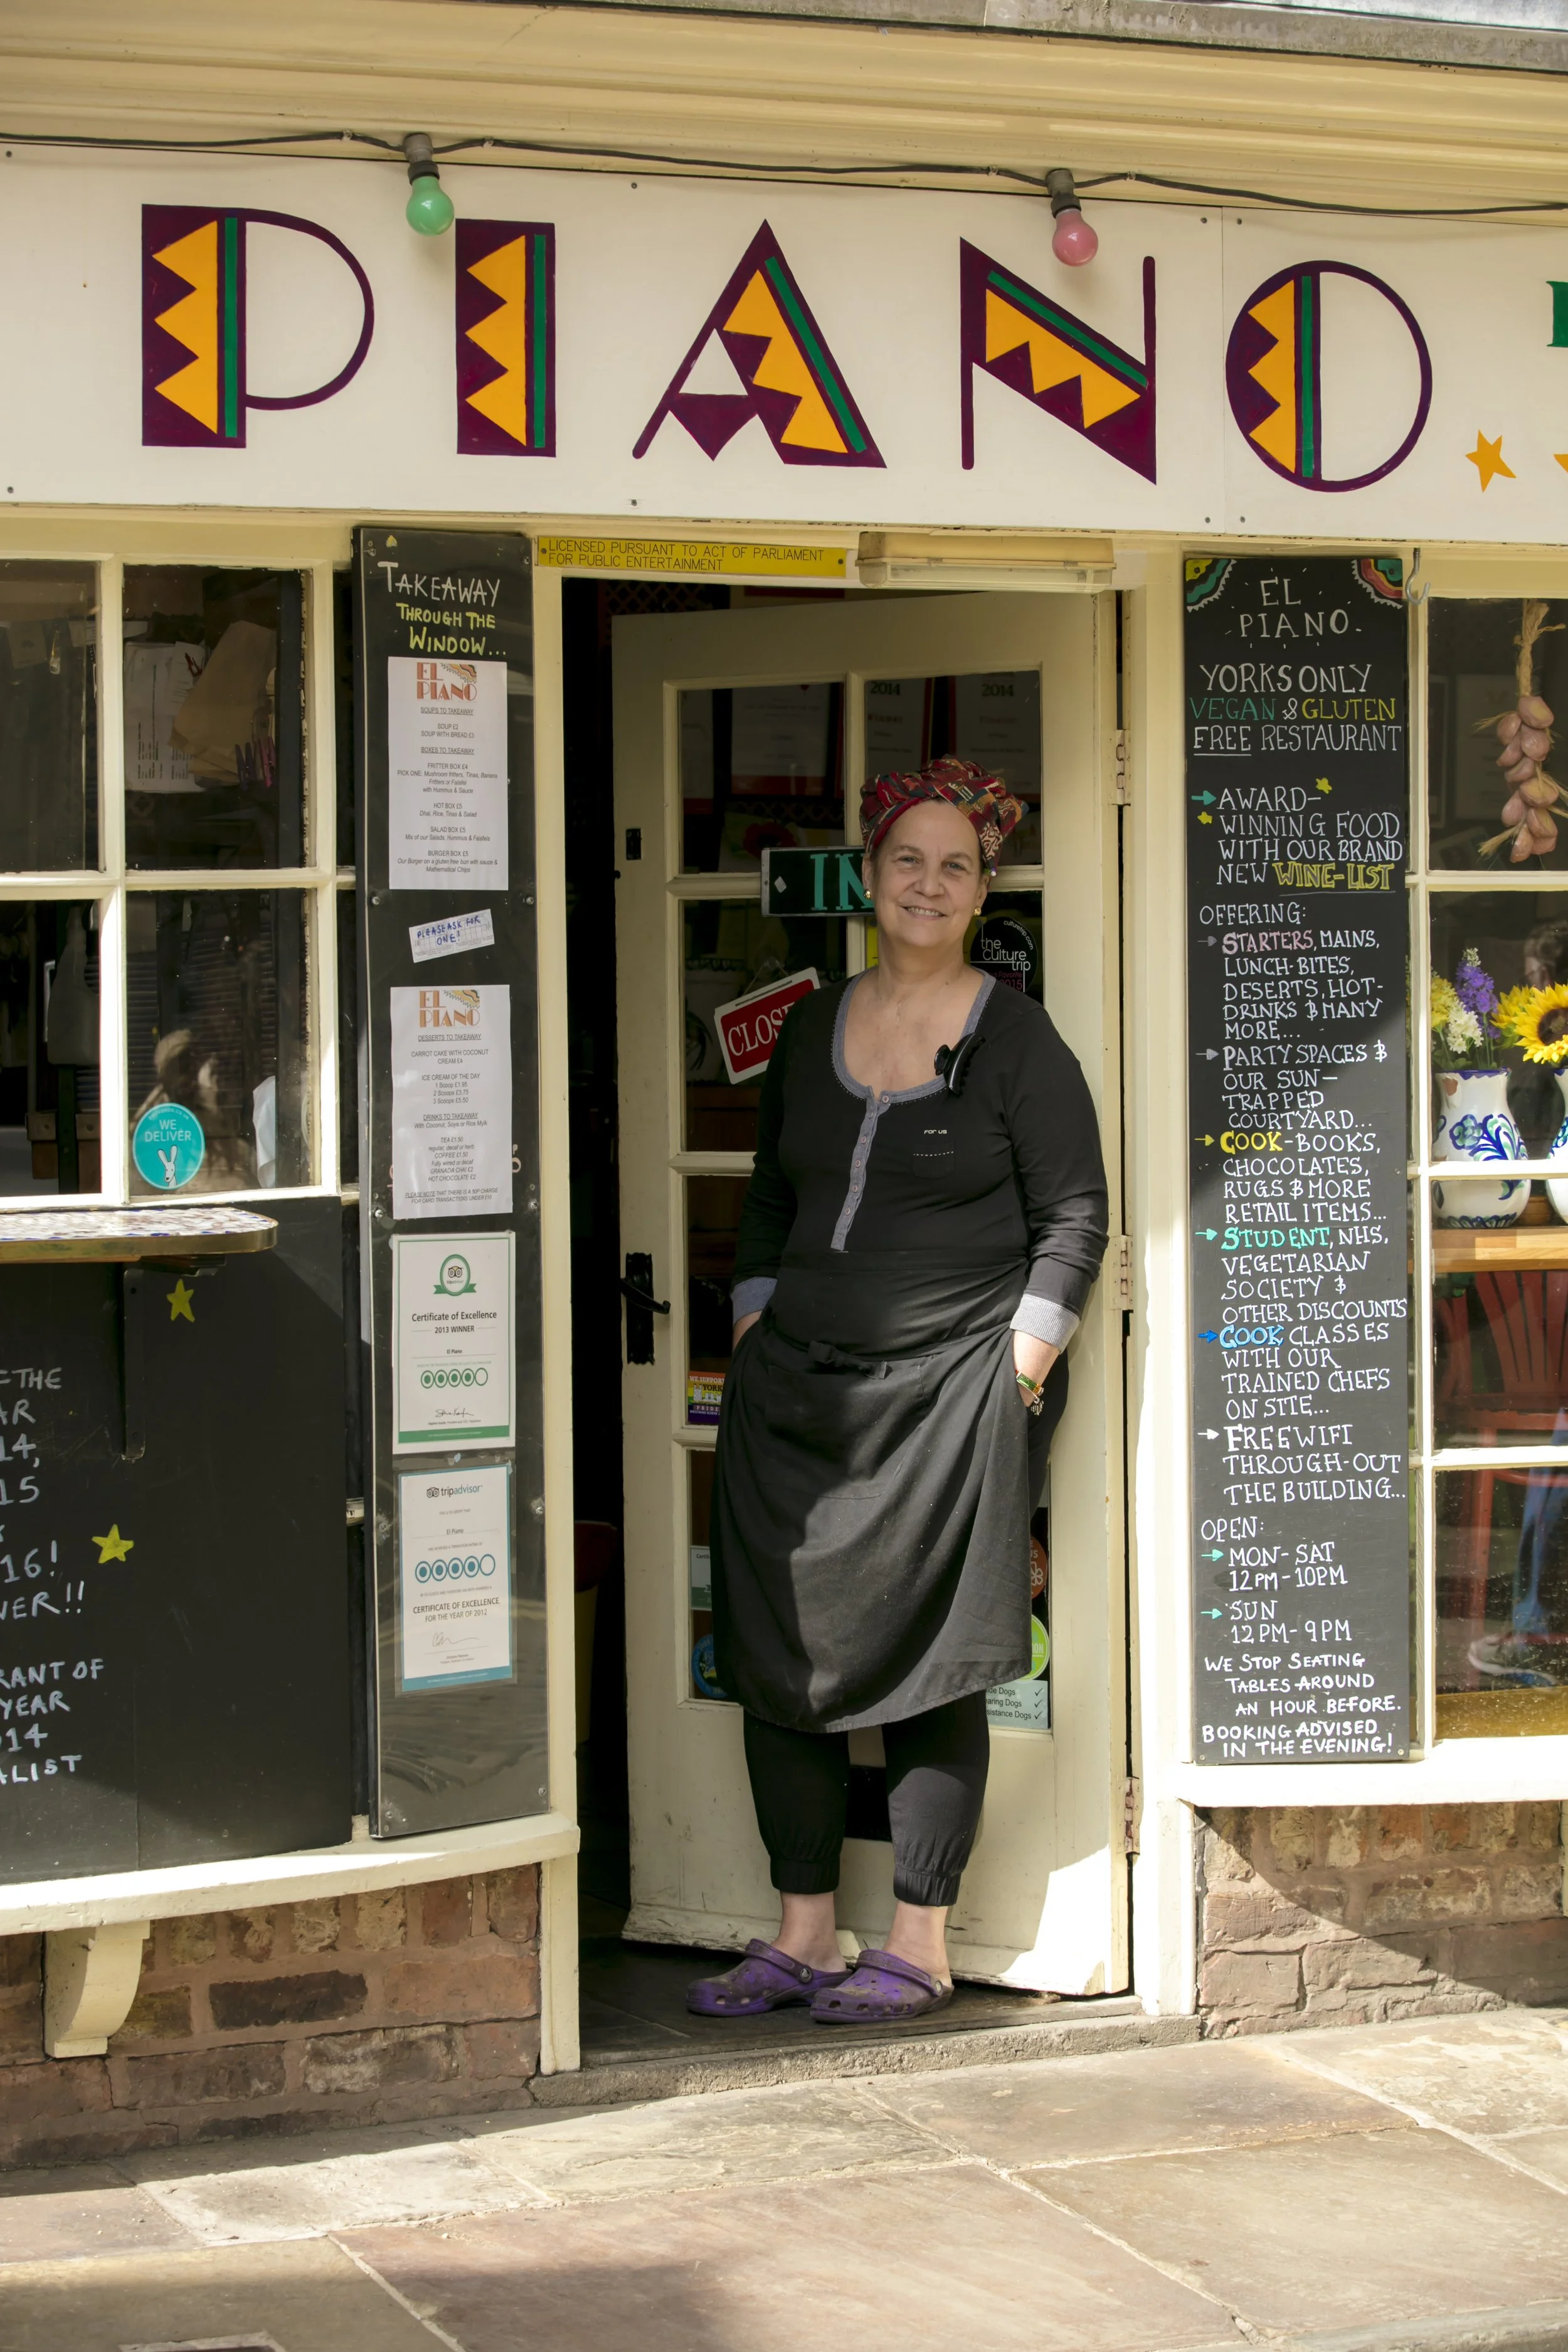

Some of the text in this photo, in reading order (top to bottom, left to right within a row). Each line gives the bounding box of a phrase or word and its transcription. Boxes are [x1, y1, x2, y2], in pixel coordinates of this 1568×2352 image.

[142, 204, 1432, 492] PIANO
[549, 539, 824, 561] LICENSED PURSUANT TO ACT OF PARLIAMENT
[549, 553, 723, 571] FOR PUBLIC ENTERTAINMENT
[378, 561, 501, 607] TAKEAWAY
[1261, 577, 1301, 606] EL
[396, 603, 496, 629] THROUGH THE
[417, 662, 443, 681] EL
[417, 681, 477, 701] PIANO
[871, 682, 901, 696] 2014
[981, 684, 1014, 697] 2014
[1189, 697, 1396, 721] VEGAN & GLUTEN
[1194, 724, 1402, 751] FREE RESTAURANT
[1220, 811, 1400, 838] WINNING FOOD
[1218, 838, 1403, 862] WITH OUR BRAND
[1216, 862, 1268, 884] NEW
[1199, 901, 1306, 926] OFFERING:
[417, 915, 480, 938] PLEASE ASK FOR
[1004, 921, 1034, 950] culturetrip.com
[437, 931, 460, 945] ONE!
[1222, 930, 1380, 955] STARTERS, MAINS,
[420, 990, 446, 1009] EL
[1223, 979, 1325, 1002] DESERTS,
[420, 1009, 480, 1027] PIANO
[728, 1002, 795, 1056] CLOS
[1222, 1090, 1324, 1111] TRAPPED
[144, 1130, 191, 1142] DELIVER
[159, 1120, 177, 1130] WE
[1223, 1157, 1369, 1177] CHOCOLATES,
[1225, 1202, 1298, 1224] RETAIL
[1221, 1224, 1389, 1251] STUDENT, NHS,
[1221, 1251, 1371, 1276] VEGETARIAN
[412, 1311, 497, 1322] Certificate of Excellence
[1222, 1298, 1407, 1325] OTHER DISCOUNTS
[1219, 1322, 1390, 1348] COOK CLASSES
[11, 1367, 62, 1390] THE
[1221, 1367, 1391, 1394] TRAINED CHEFS
[1226, 1398, 1258, 1420] ON
[1223, 1424, 1353, 1452] FREE WIFI
[441, 1484, 482, 1497] tripadvisor
[1224, 1482, 1276, 1505] THE
[1201, 1516, 1264, 1542] OPEN:
[413, 1603, 450, 1614] CERTIFICATE
[462, 1597, 499, 1608] EXCELLENCE
[450, 1611, 464, 1619] YEAR
[1230, 1599, 1278, 1621] SUN
[73, 1658, 104, 1680] OF
[1204, 1652, 1365, 1672] WE STOP SEATING
[999, 1687, 1015, 1697] Dogs
[1224, 1673, 1375, 1693] TABLES AROUND
[1005, 1698, 1022, 1708] Dogs
[1235, 1695, 1402, 1717] AN HOUR BEFORE.
[1014, 1710, 1032, 1720] Dogs
[1202, 1719, 1377, 1743] BOOKING ADVISED
[1223, 1732, 1392, 1757] IN THE EVENING!
